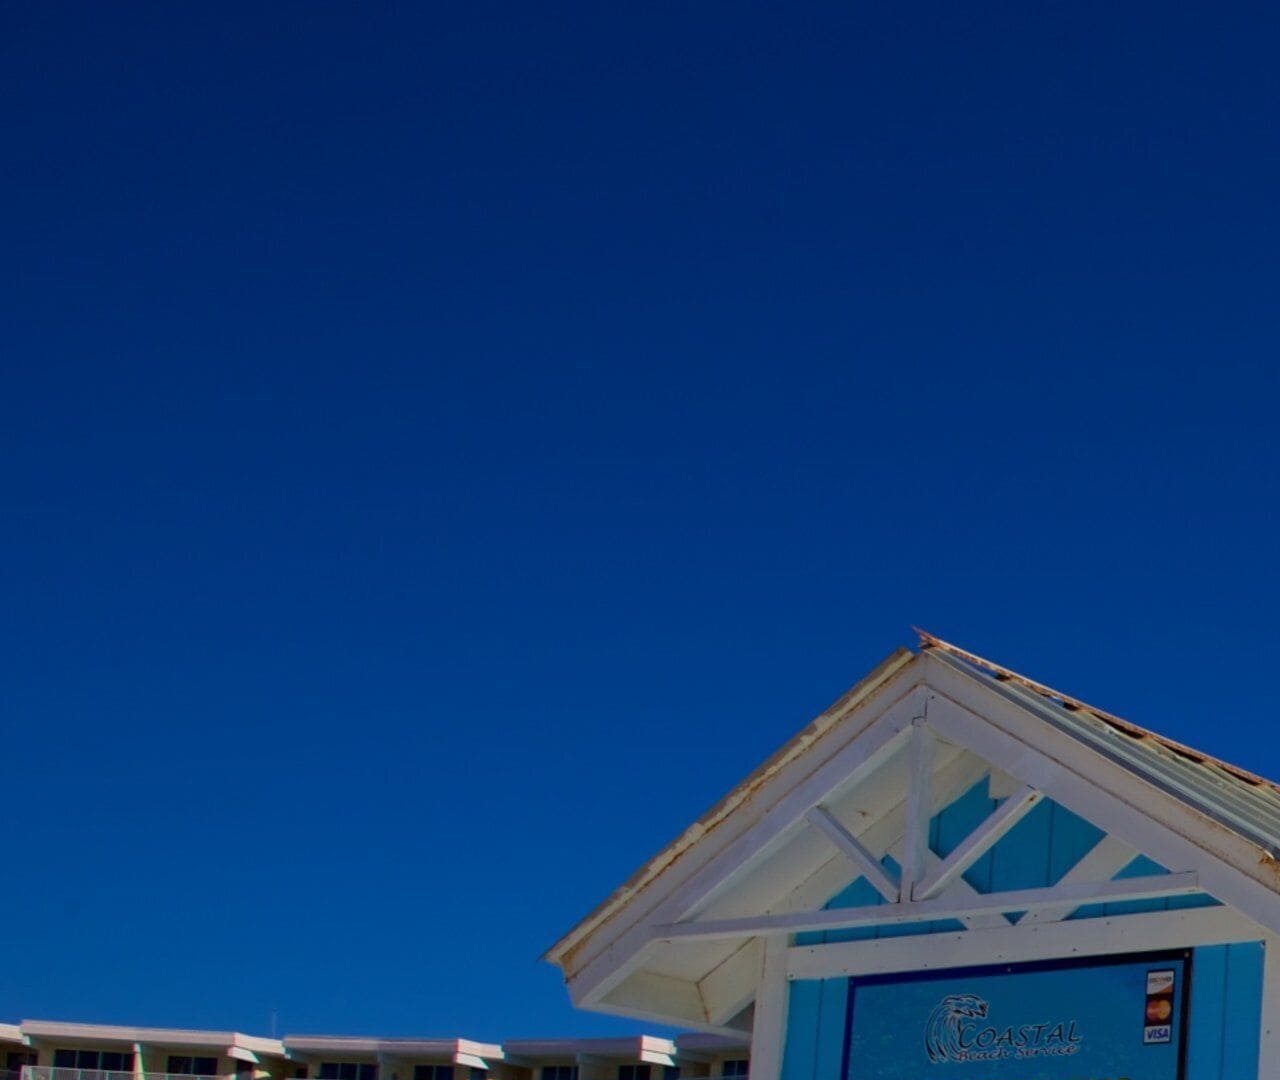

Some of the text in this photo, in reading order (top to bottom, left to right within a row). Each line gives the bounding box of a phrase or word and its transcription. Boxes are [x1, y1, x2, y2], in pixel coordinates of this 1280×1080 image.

[958, 1020, 1083, 1049] COASTAL
[1147, 1028, 1169, 1039] VISA
[957, 1043, 1080, 1062] Beach Service
